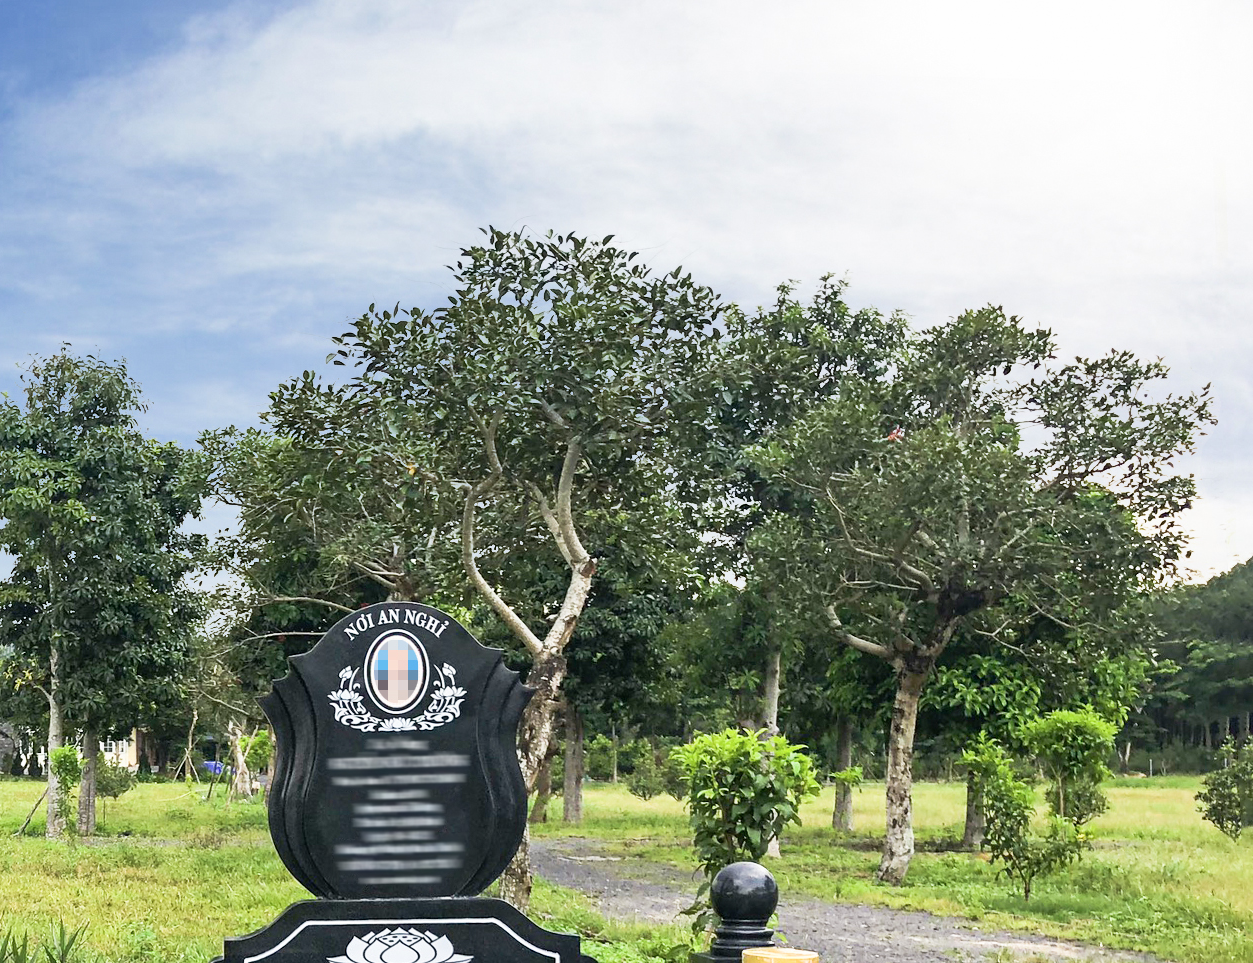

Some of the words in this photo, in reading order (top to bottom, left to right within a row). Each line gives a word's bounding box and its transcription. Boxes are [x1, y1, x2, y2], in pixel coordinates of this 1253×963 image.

[343, 613, 375, 641] NƠI
[378, 608, 400, 625] AN
[403, 608, 450, 638] NGHỈ
